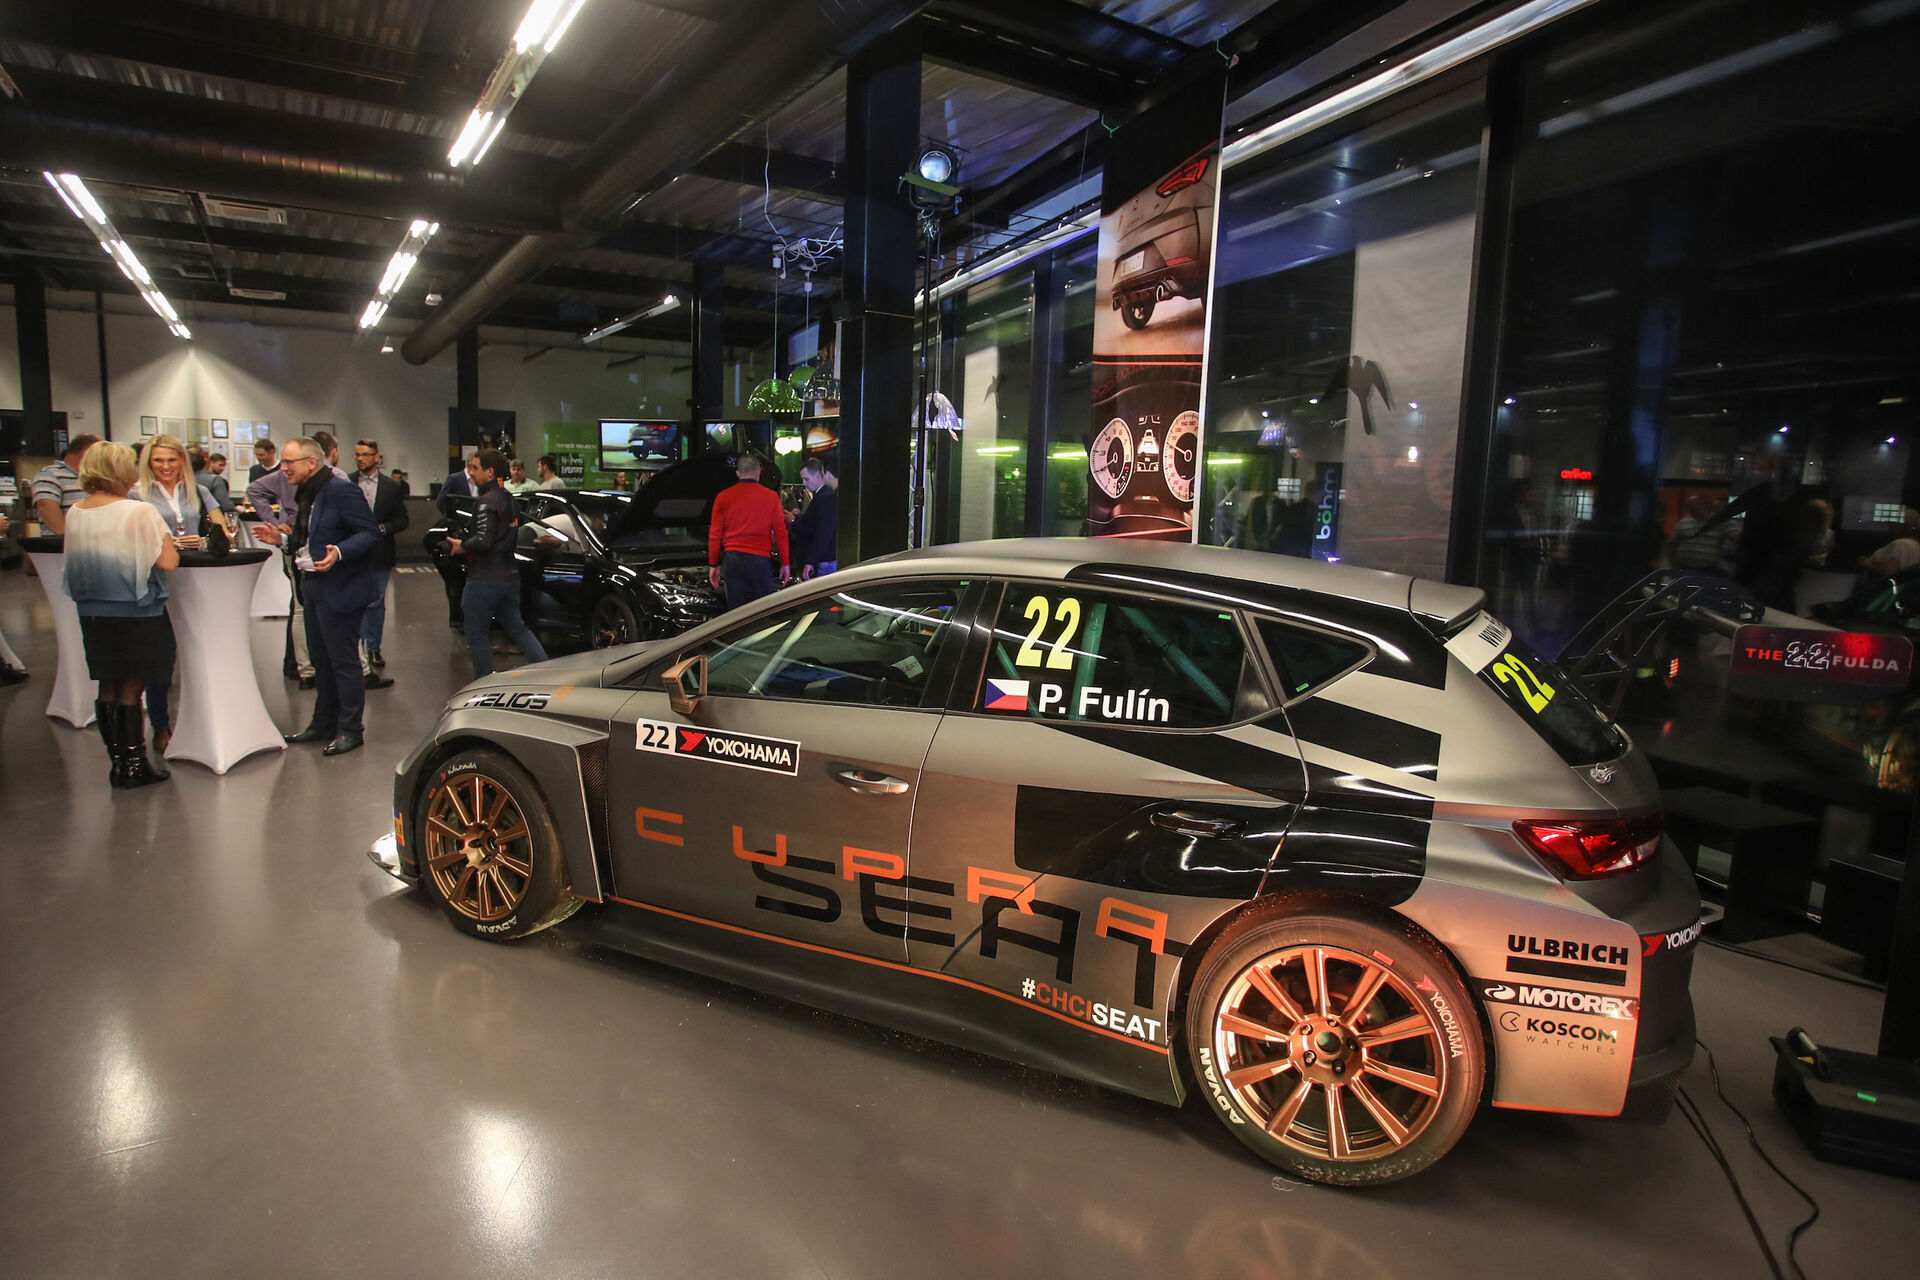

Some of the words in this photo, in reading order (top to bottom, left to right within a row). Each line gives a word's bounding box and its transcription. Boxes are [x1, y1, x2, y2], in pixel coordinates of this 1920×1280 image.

[1015, 595, 1081, 671] 22
[1745, 647, 1784, 661] THE
[1832, 655, 1899, 672] FULDA
[1492, 652, 1556, 714] 22
[463, 692, 552, 710] HELIOS
[1038, 683, 1067, 715] P.
[1078, 686, 1170, 722] Fulín
[642, 723, 670, 749] 22
[705, 736, 792, 766] YOKOHAMA
[635, 806, 1168, 956] CUPRA
[1507, 934, 1629, 966] ULBRICH
[1518, 985, 1634, 1018] MOTOREX
[1429, 991, 1463, 1058] YOKOHAMA
[1526, 1017, 1618, 1044] KOSCOM
[1526, 1034, 1616, 1056] WATCHES
[1200, 1047, 1246, 1126] ADVAN
